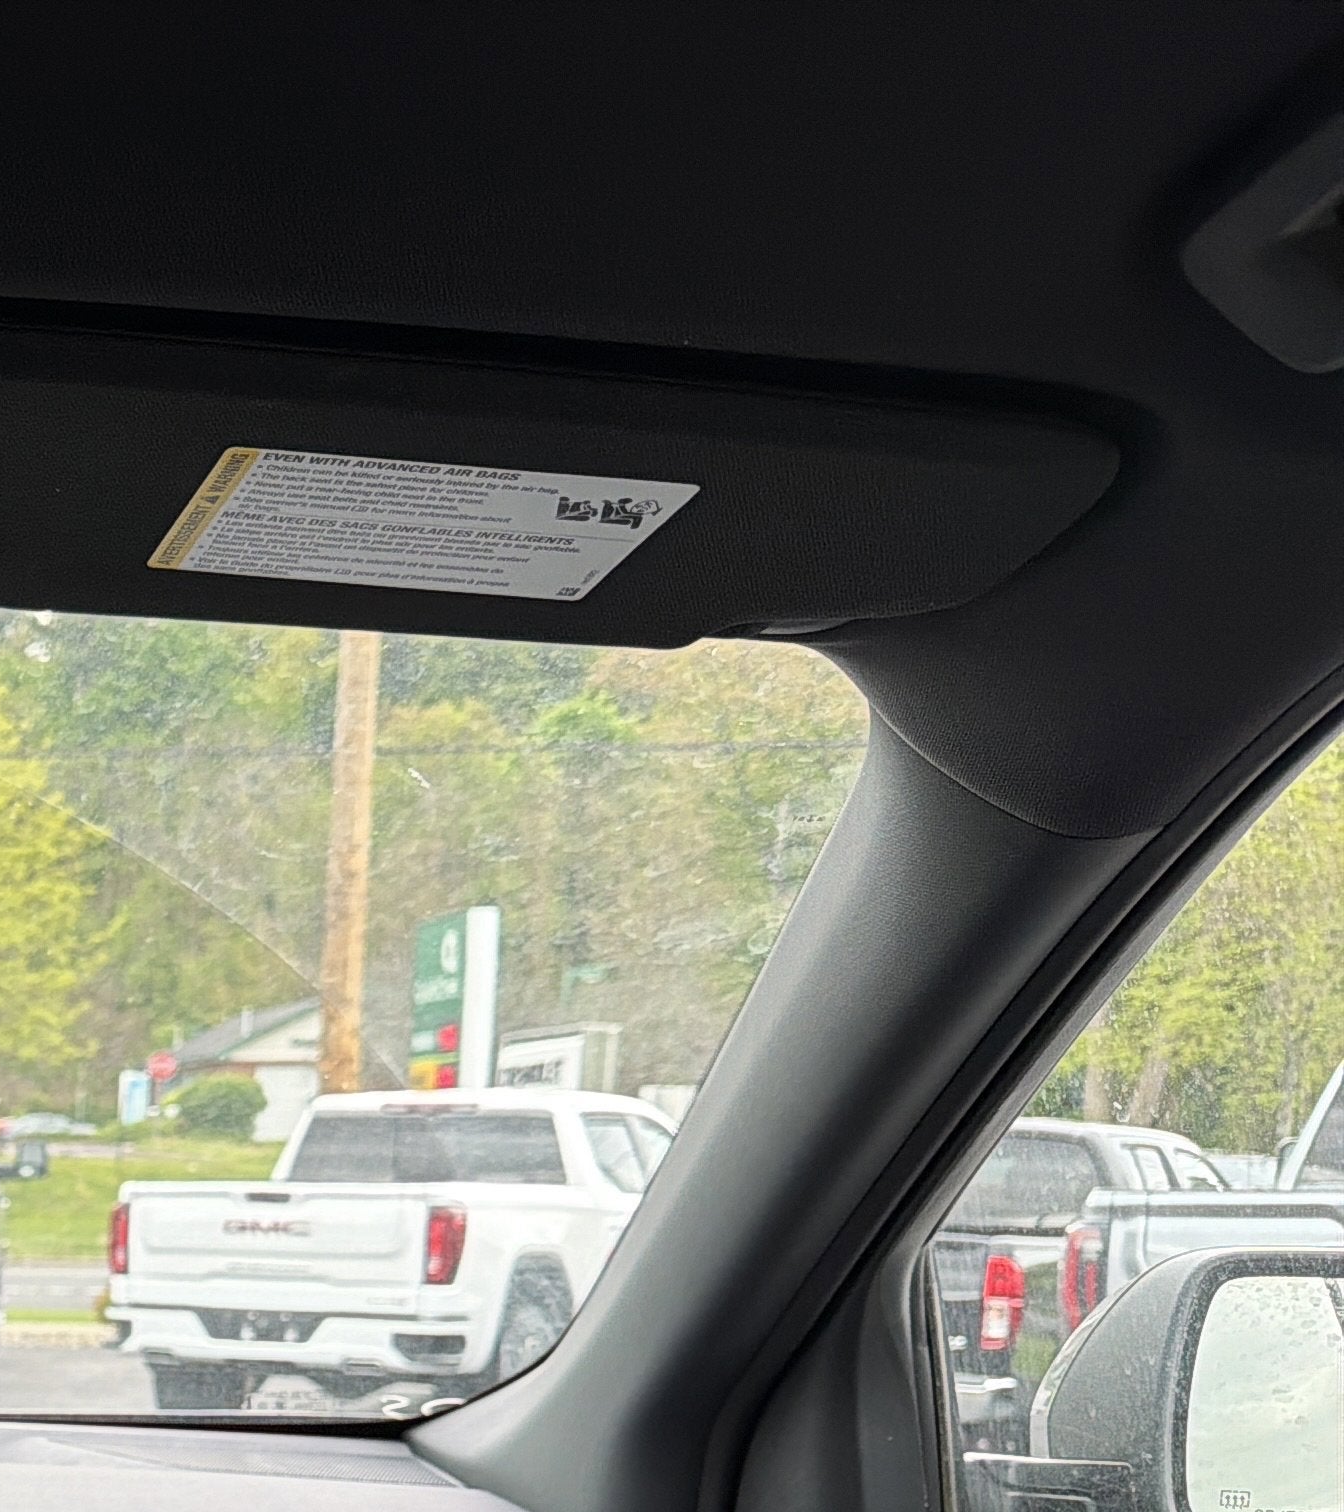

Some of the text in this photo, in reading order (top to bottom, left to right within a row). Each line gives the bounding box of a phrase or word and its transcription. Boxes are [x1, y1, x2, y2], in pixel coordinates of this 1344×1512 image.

[206, 454, 250, 492] WARNING
[264, 452, 521, 481] EVEN WITH ADVANCED AIR BAGS
[266, 514, 306, 525] AVEC
[308, 518, 338, 528] DES
[339, 521, 380, 532] SACS
[381, 524, 473, 538] GONFLABLES
[475, 531, 575, 546] INTELLIGENTS
